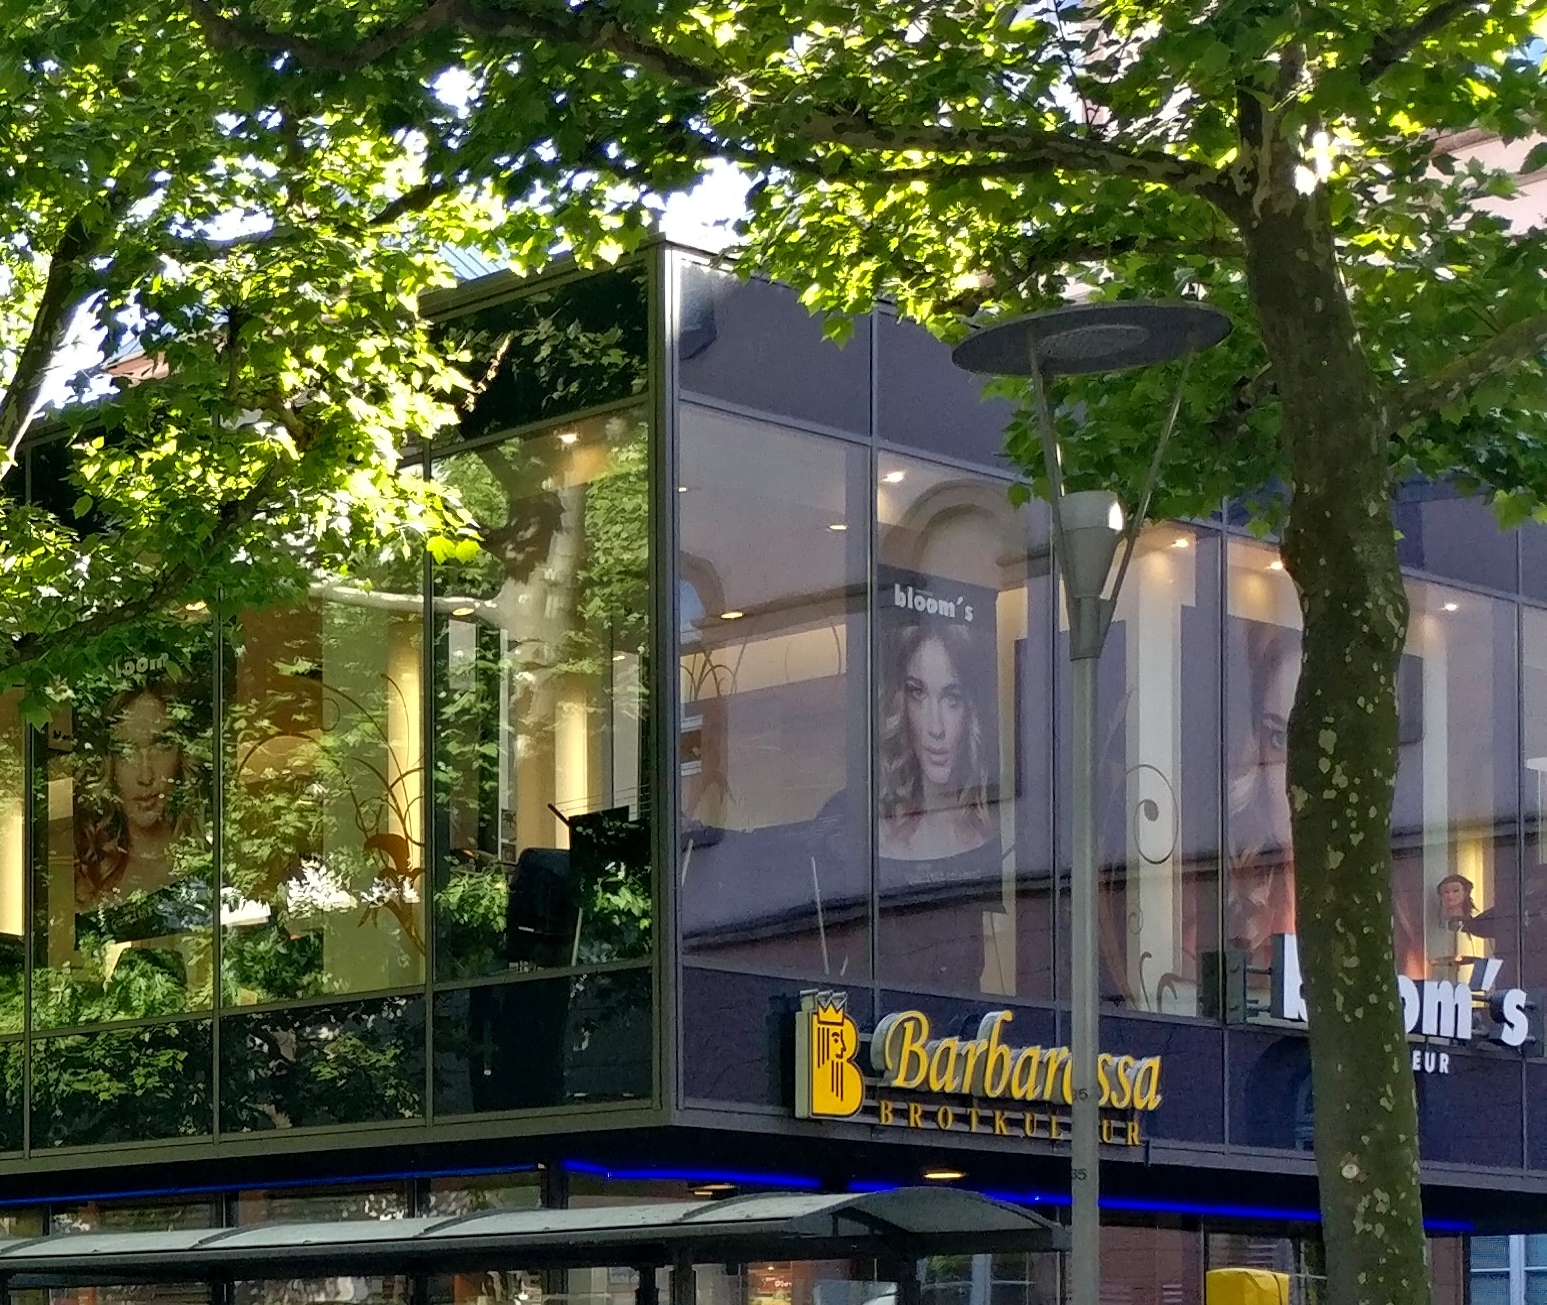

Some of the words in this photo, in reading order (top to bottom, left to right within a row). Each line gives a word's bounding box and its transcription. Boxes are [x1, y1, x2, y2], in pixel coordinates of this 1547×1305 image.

[1283, 933, 1529, 1047] bom's
[1412, 1050, 1450, 1074] EUR
[878, 1099, 1142, 1146] BROTKULUR
